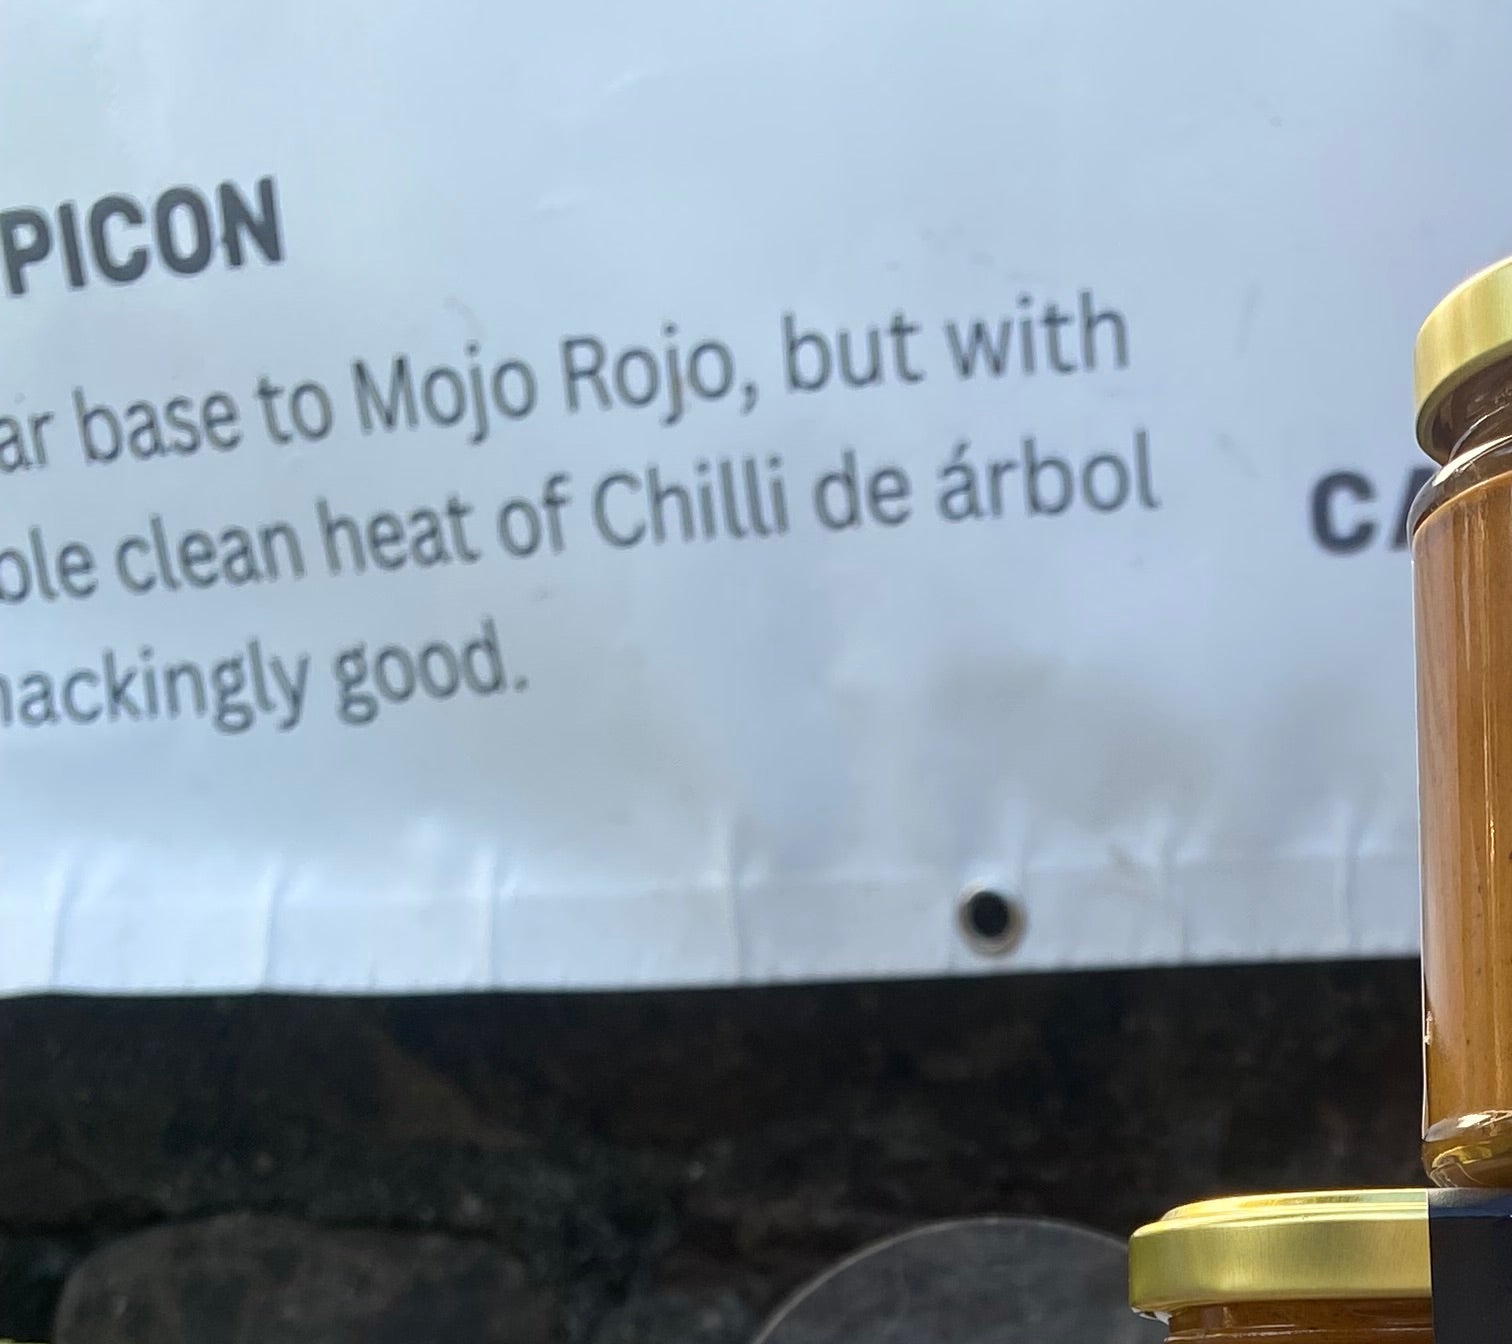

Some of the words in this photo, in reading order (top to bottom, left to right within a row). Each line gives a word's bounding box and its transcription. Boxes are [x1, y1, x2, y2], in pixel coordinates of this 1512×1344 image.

[0, 176, 283, 295] PICON
[72, 386, 243, 466] base
[257, 376, 334, 446] to
[351, 341, 538, 446] Mojo
[561, 321, 760, 427] Rojo,
[781, 312, 925, 393] but
[944, 288, 1129, 380] with
[115, 513, 304, 596] clean
[316, 494, 481, 576] heat
[497, 471, 572, 559] of
[593, 454, 791, 549] Chilli
[814, 447, 912, 530] de
[938, 427, 1162, 522] árbol
[334, 615, 530, 727] good.
